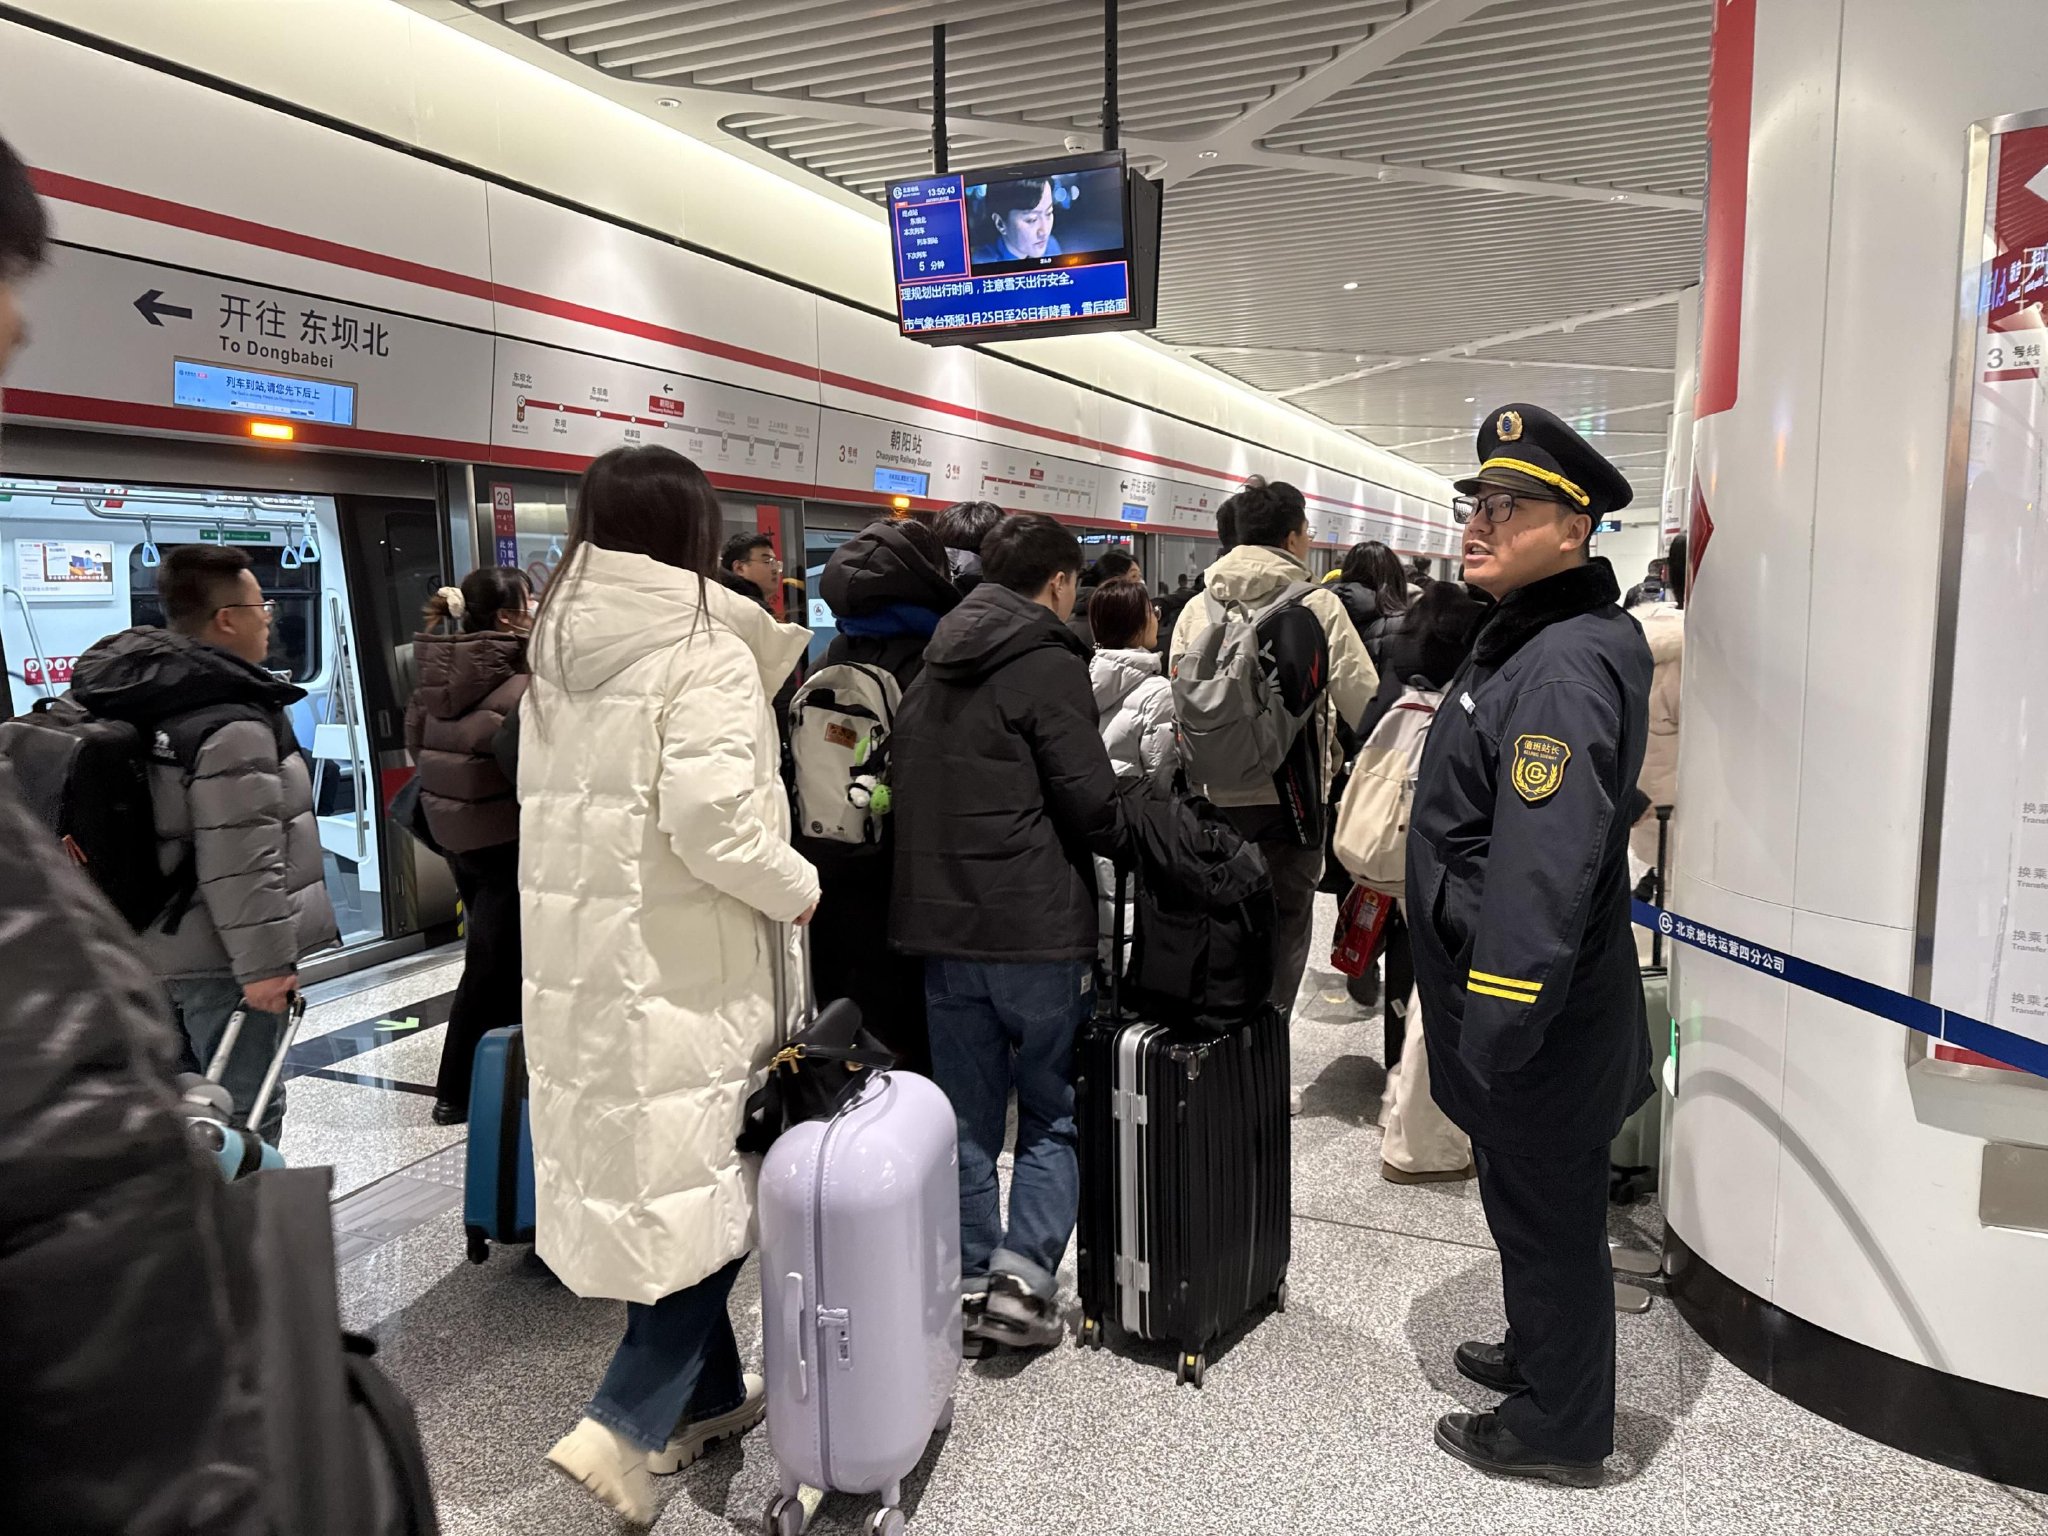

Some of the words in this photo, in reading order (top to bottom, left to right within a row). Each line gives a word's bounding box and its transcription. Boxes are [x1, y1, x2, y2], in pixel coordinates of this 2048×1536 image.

[928, 186, 955, 197] 13:50:43
[919, 261, 925, 271] 5
[930, 260, 945, 271] 分钟
[219, 294, 287, 339] 开往
[300, 309, 389, 357] 东坝北
[219, 335, 241, 353] To
[247, 340, 334, 368] Dongbabei
[1986, 347, 2004, 369] 3
[2012, 344, 2040, 358] 号线
[513, 372, 533, 384] 东坝北
[226, 376, 320, 400] 列车到站,请您先下后上
[890, 429, 923, 454] 朝阳站
[839, 445, 846, 463] 3
[875, 449, 899, 464] Chaoyang
[899, 454, 917, 467] Railway
[917, 458, 932, 468] Station
[945, 464, 951, 479] 3
[496, 491, 510, 506] 29
[1525, 740, 1560, 756] 值班站长
[1675, 920, 1785, 974] 北京地铁运营四分公司
[2012, 942, 2046, 953] Transfer
[2010, 1005, 2046, 1017] Transfer
